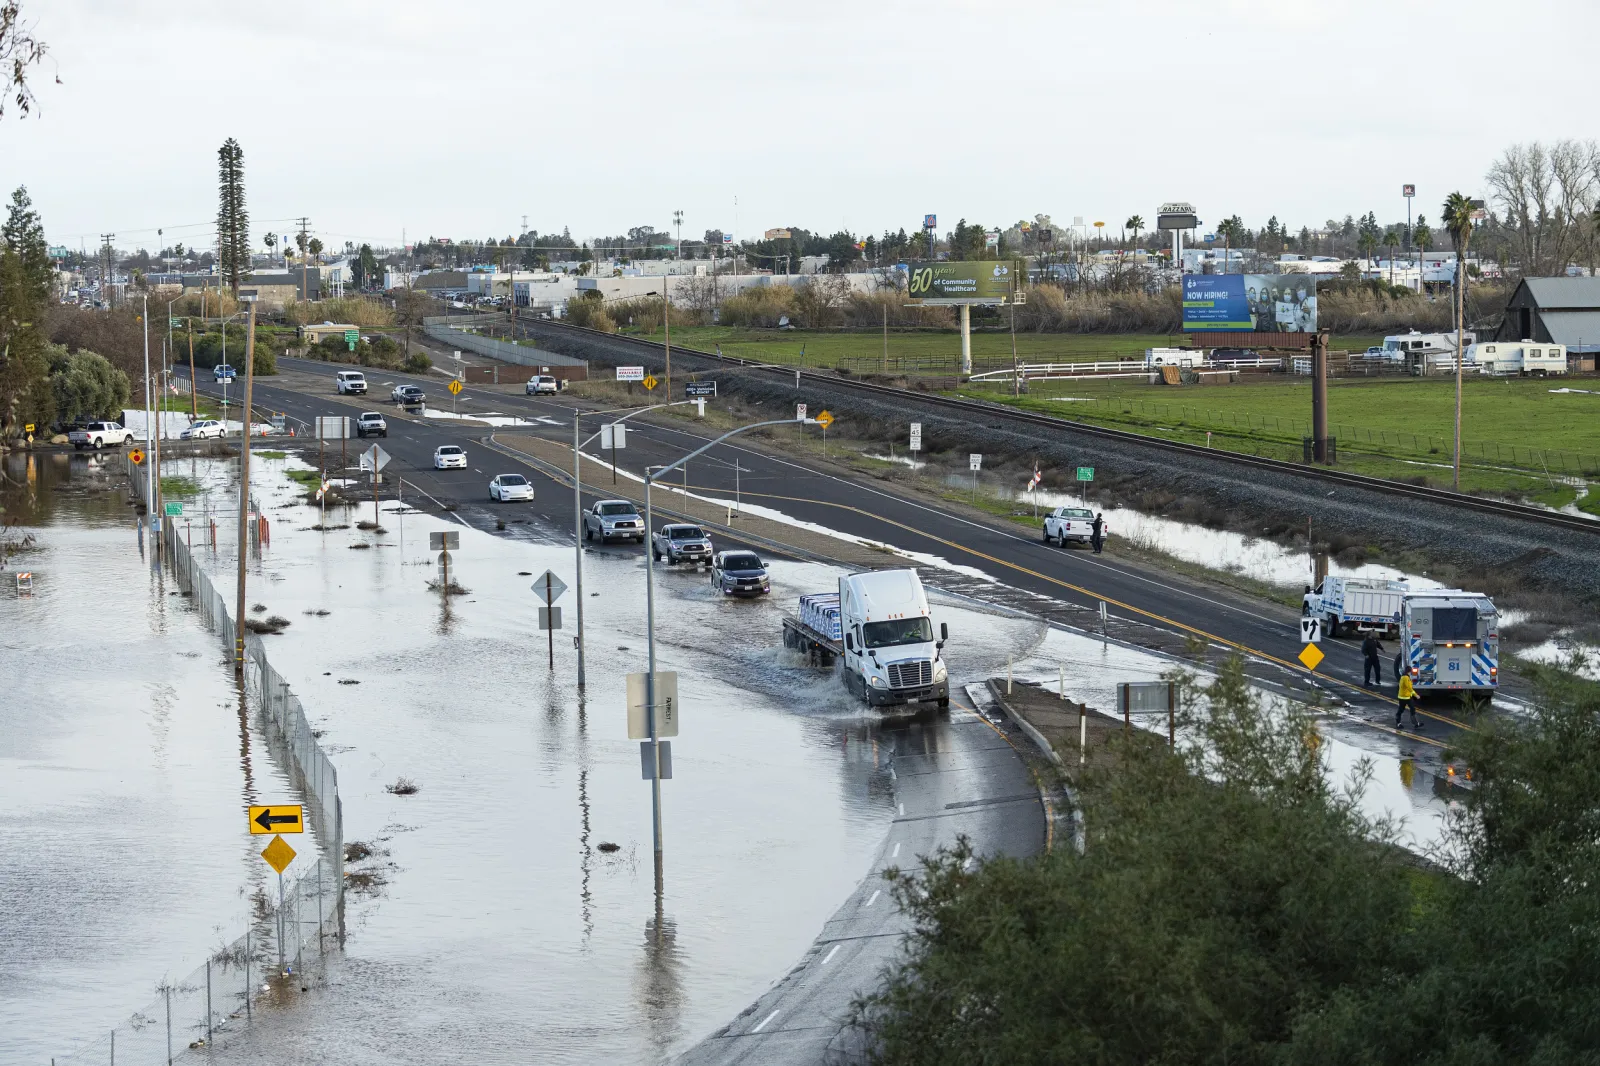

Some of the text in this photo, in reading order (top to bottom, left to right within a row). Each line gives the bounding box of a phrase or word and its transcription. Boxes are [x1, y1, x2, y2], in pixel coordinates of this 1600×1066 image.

[910, 267, 956, 293] 50 years
[1187, 291, 1228, 300] NOW HIRING!
[1448, 662, 1460, 671] 81
